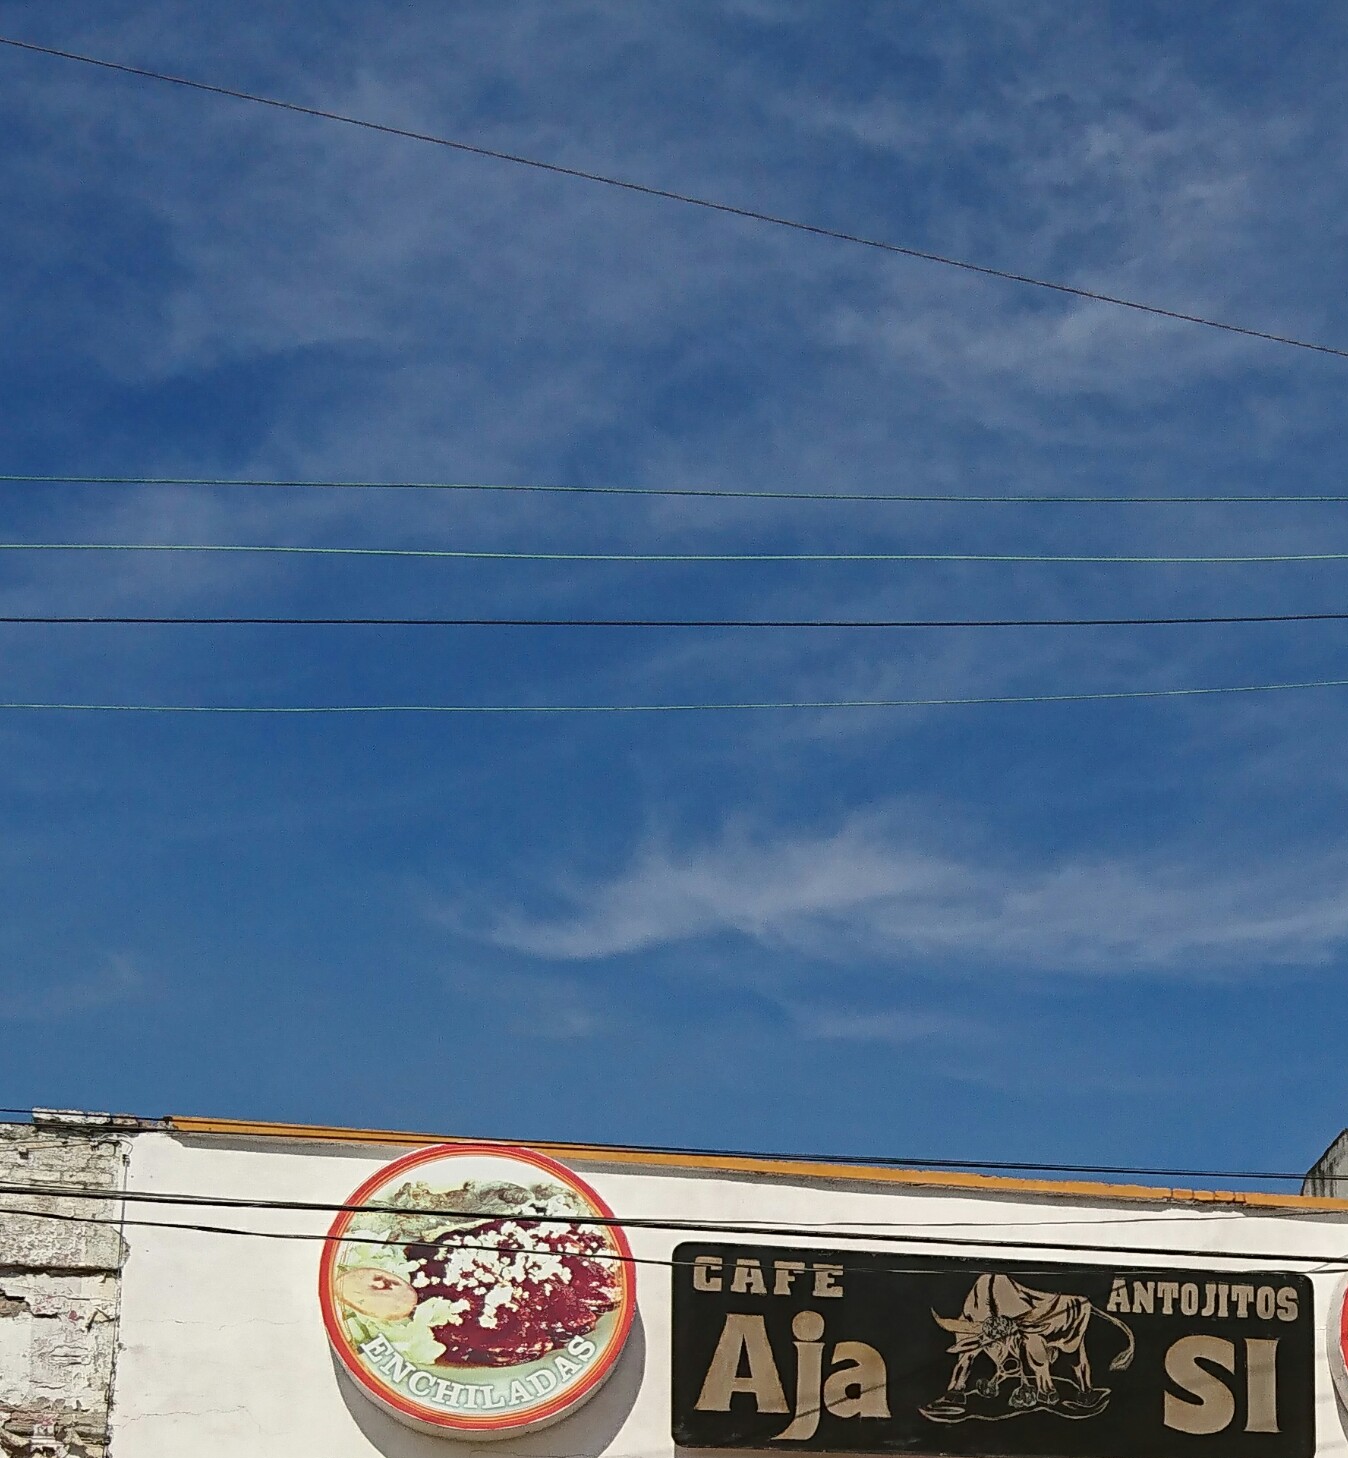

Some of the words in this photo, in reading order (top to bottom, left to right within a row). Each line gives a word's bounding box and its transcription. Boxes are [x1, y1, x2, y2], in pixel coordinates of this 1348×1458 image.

[693, 1256, 844, 1298] CAFE
[1106, 1276, 1299, 1323] ANTOJITOS
[360, 1333, 597, 1410] ENCHILADAS
[693, 1307, 892, 1441] Aja
